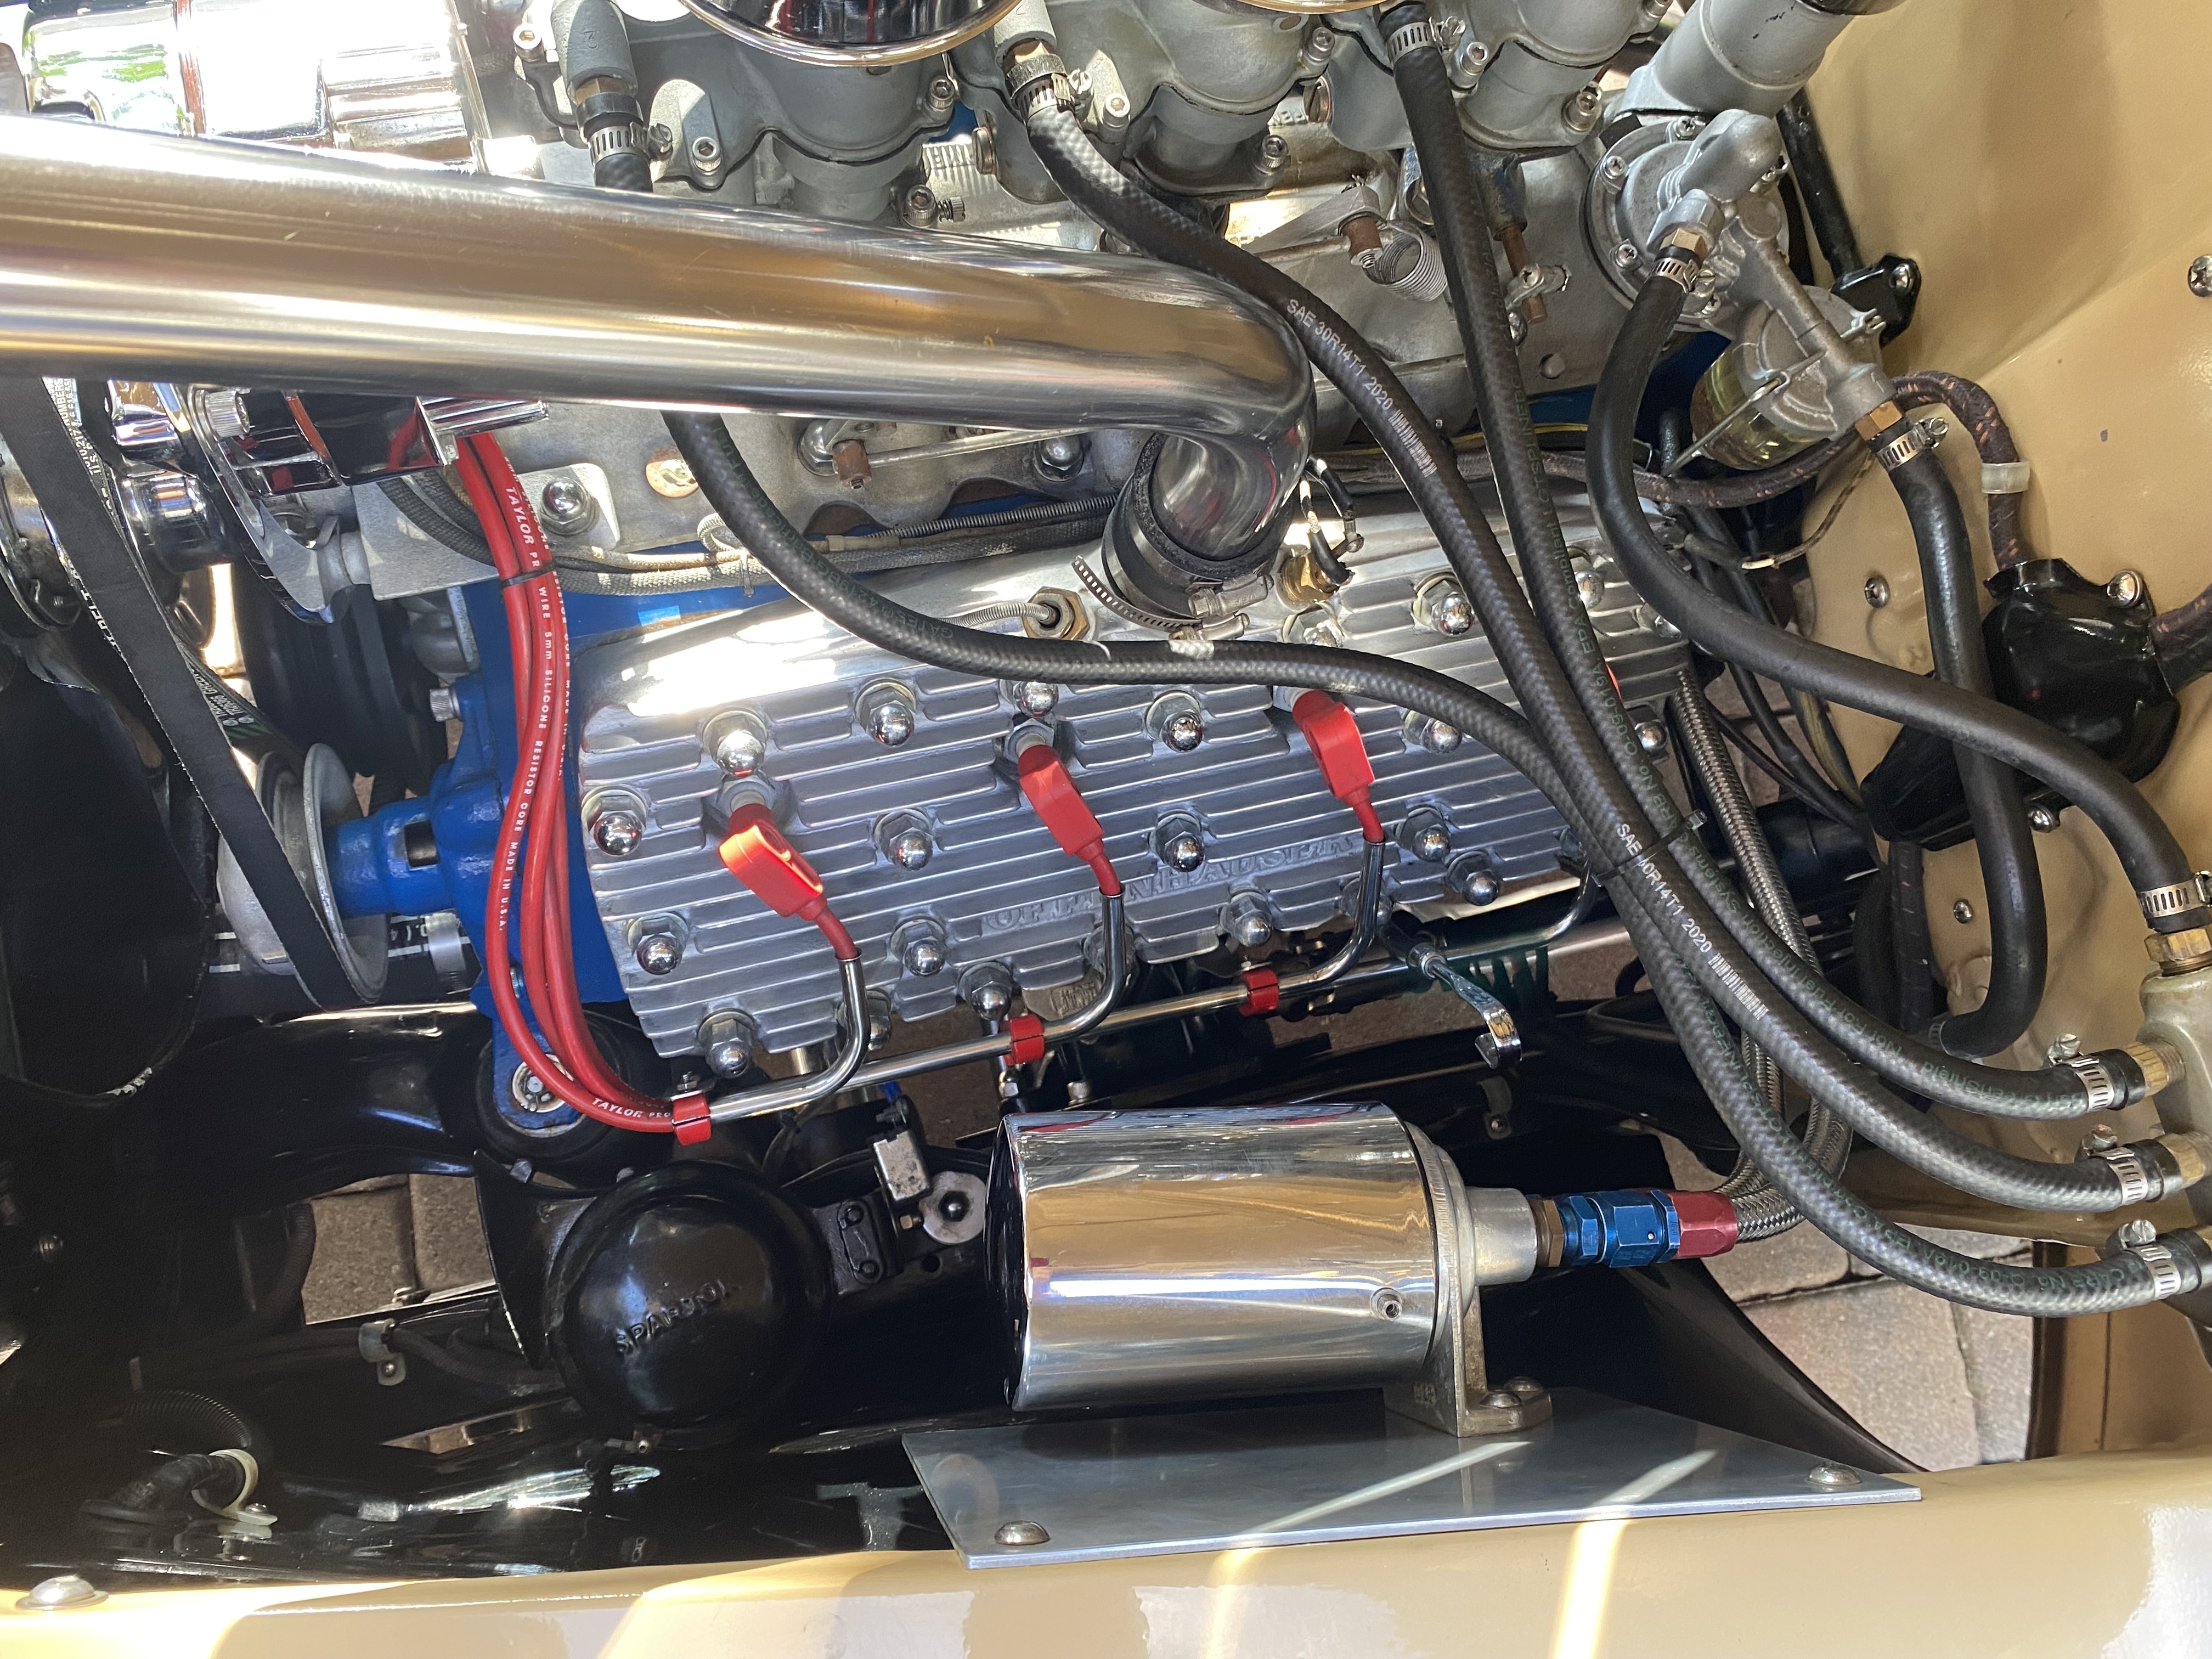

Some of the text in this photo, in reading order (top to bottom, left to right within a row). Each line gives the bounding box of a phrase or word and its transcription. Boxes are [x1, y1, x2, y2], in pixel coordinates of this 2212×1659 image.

[1286, 298, 1393, 410] SAE 30R14T1 2020
[506, 487, 534, 545] TAYLOR
[538, 586, 551, 619] WIRE
[544, 631, 553, 661] 8mm
[1573, 616, 1596, 654] EPA
[539, 669, 552, 730] SILICONE
[523, 740, 543, 795] RESISTOR
[514, 802, 528, 832] CORE
[505, 842, 518, 872] MADE
[501, 878, 512, 890] IN
[1617, 823, 1643, 856] SAE
[1681, 918, 1712, 953] 2020
[1684, 845, 1743, 915] Systems
[498, 897, 509, 932] U.S.A.
[1738, 912, 1802, 979] Injection
[1795, 974, 1837, 1012] Fuel
[1837, 1006, 1867, 1034] For
[1870, 1029, 1903, 1057] Not
[592, 1098, 644, 1118] TAYLOR
